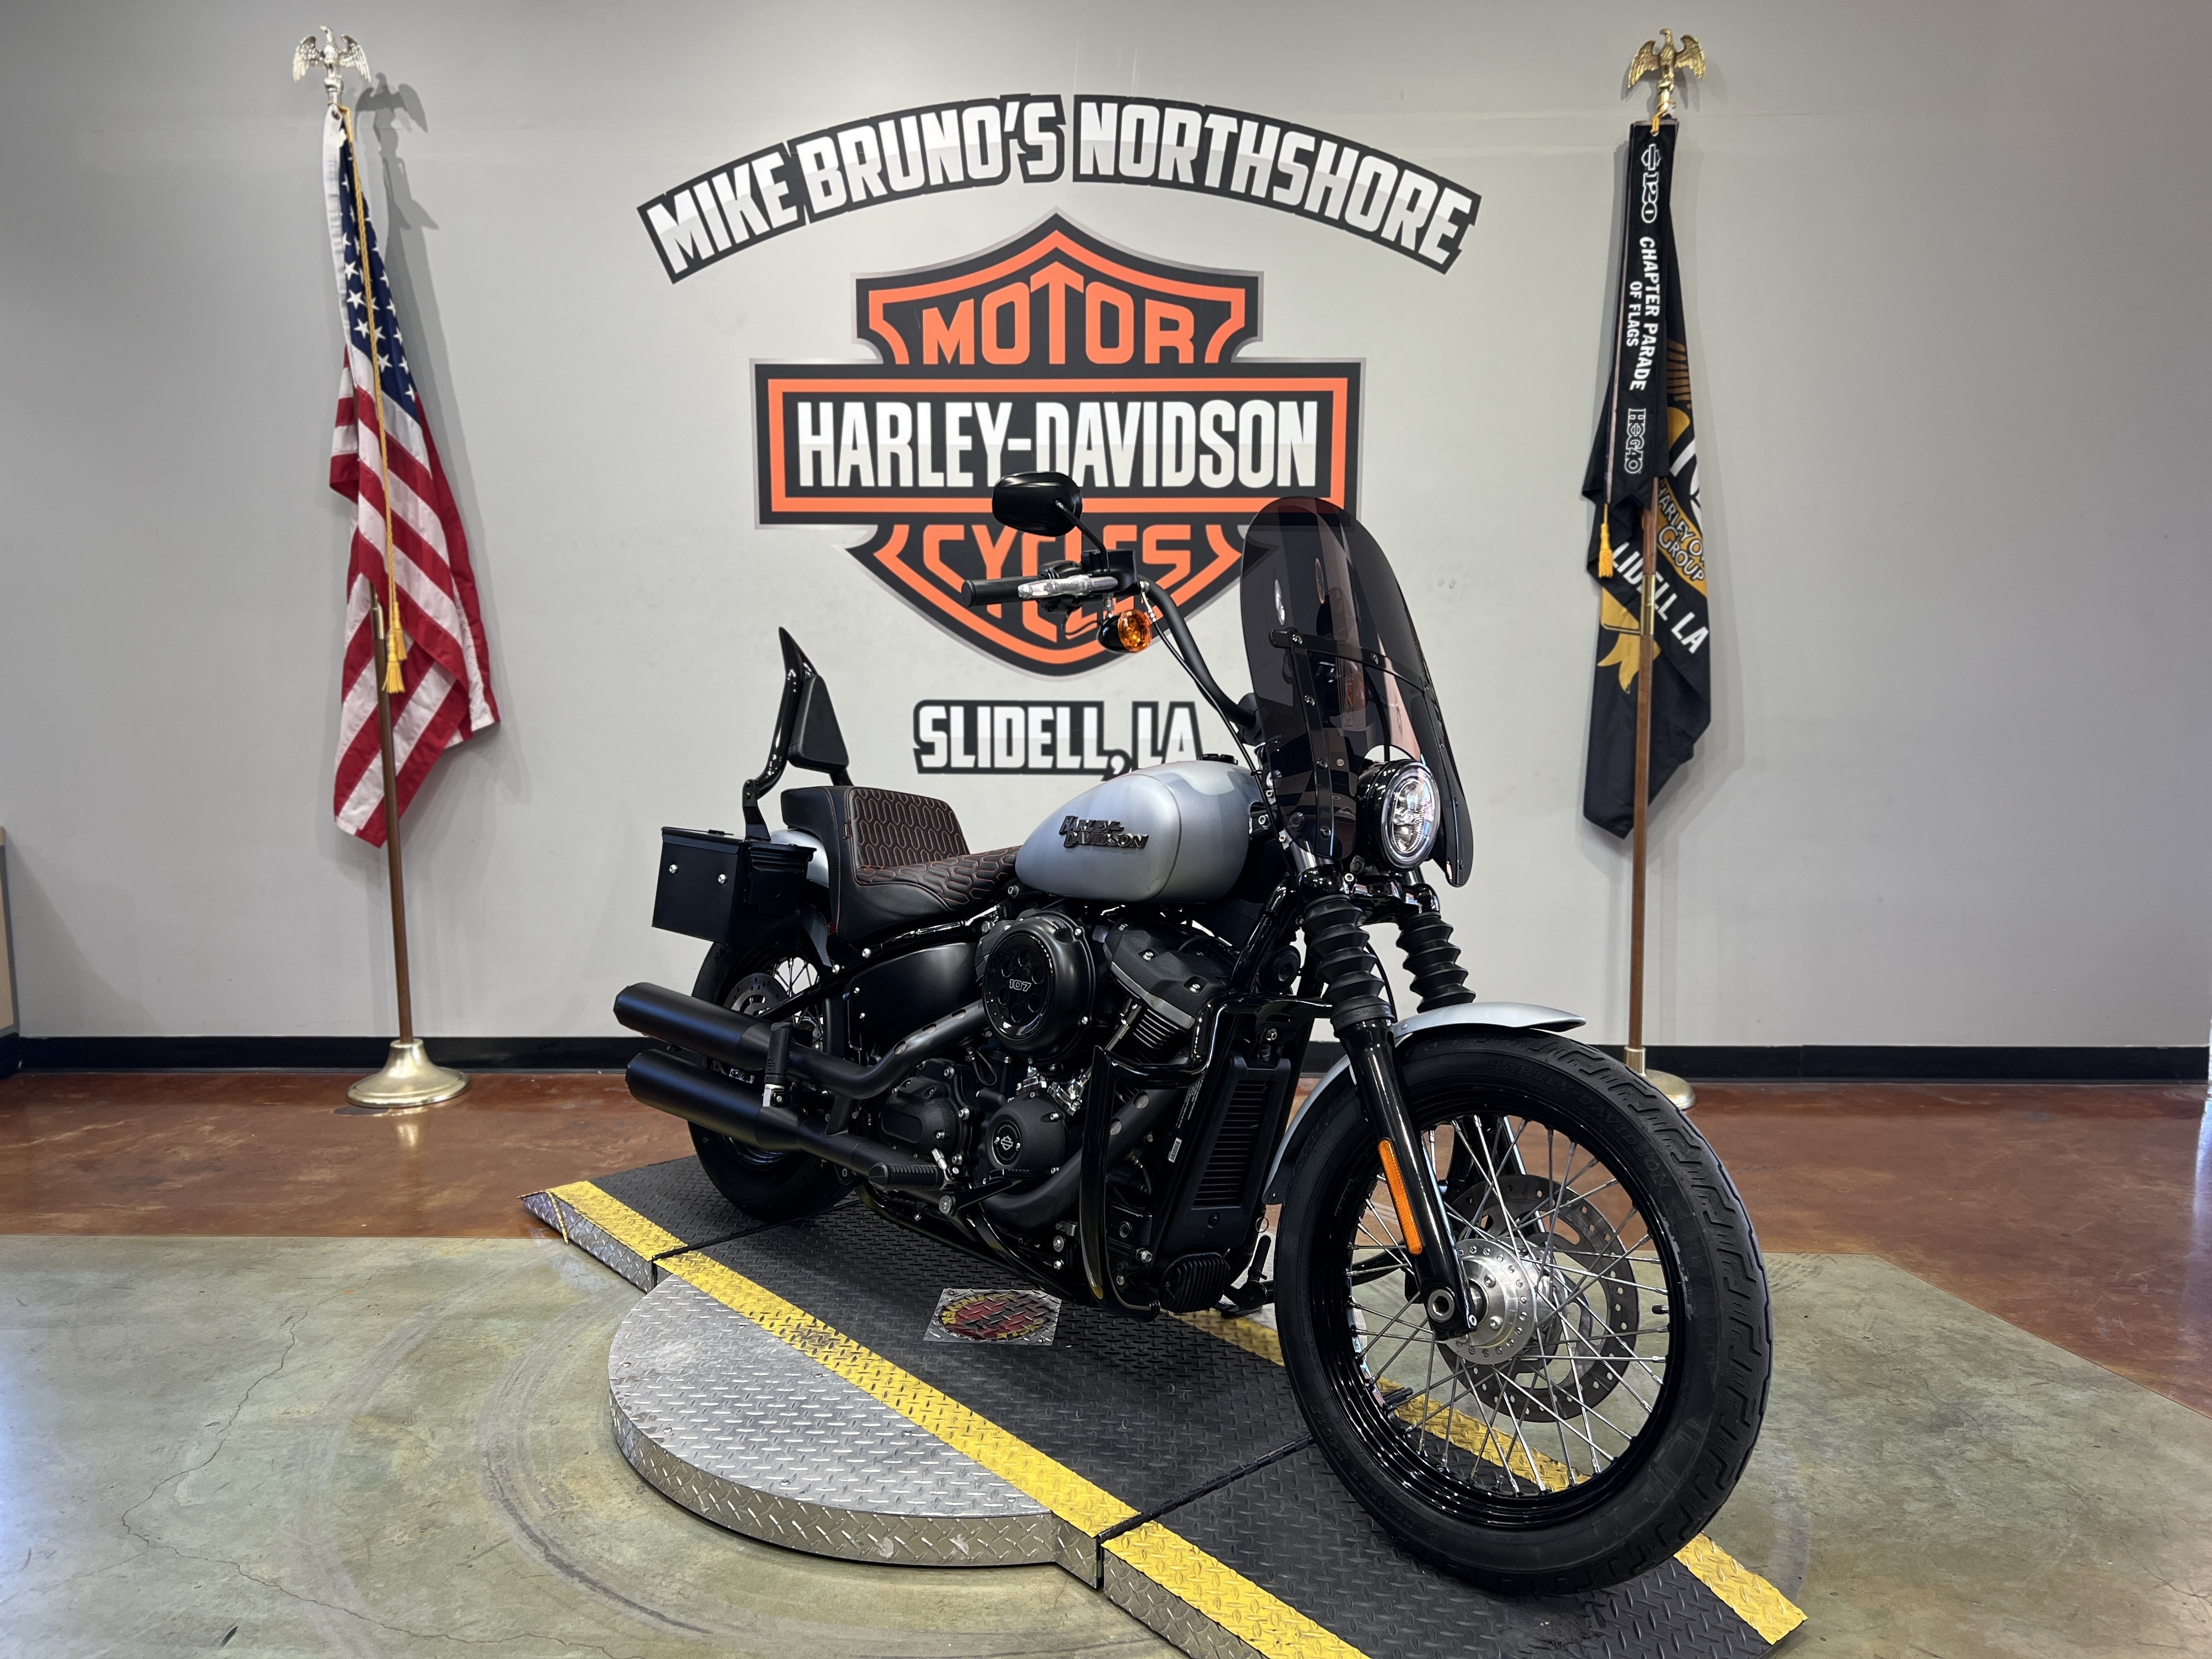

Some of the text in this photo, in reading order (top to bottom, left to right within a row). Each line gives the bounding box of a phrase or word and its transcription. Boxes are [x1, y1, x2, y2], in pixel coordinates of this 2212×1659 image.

[646, 100, 1473, 274] MIKE BRUNO'S NORTHSHORE
[922, 260, 1195, 365] MOTOR
[1626, 281, 1643, 347] OF FLAGS
[1629, 236, 1661, 391] CHAPTER PARADE
[797, 399, 1318, 488] HARLEY-DAVIDSON
[1658, 525, 1705, 581] GROUP
[1671, 612, 1709, 654] LA
[1137, 707, 1198, 769] LA
[1063, 831, 1149, 849] DAVIDSON
[1009, 979, 1031, 992] 107
[1486, 1058, 1672, 1189] HARLEY-DAVIDSON
